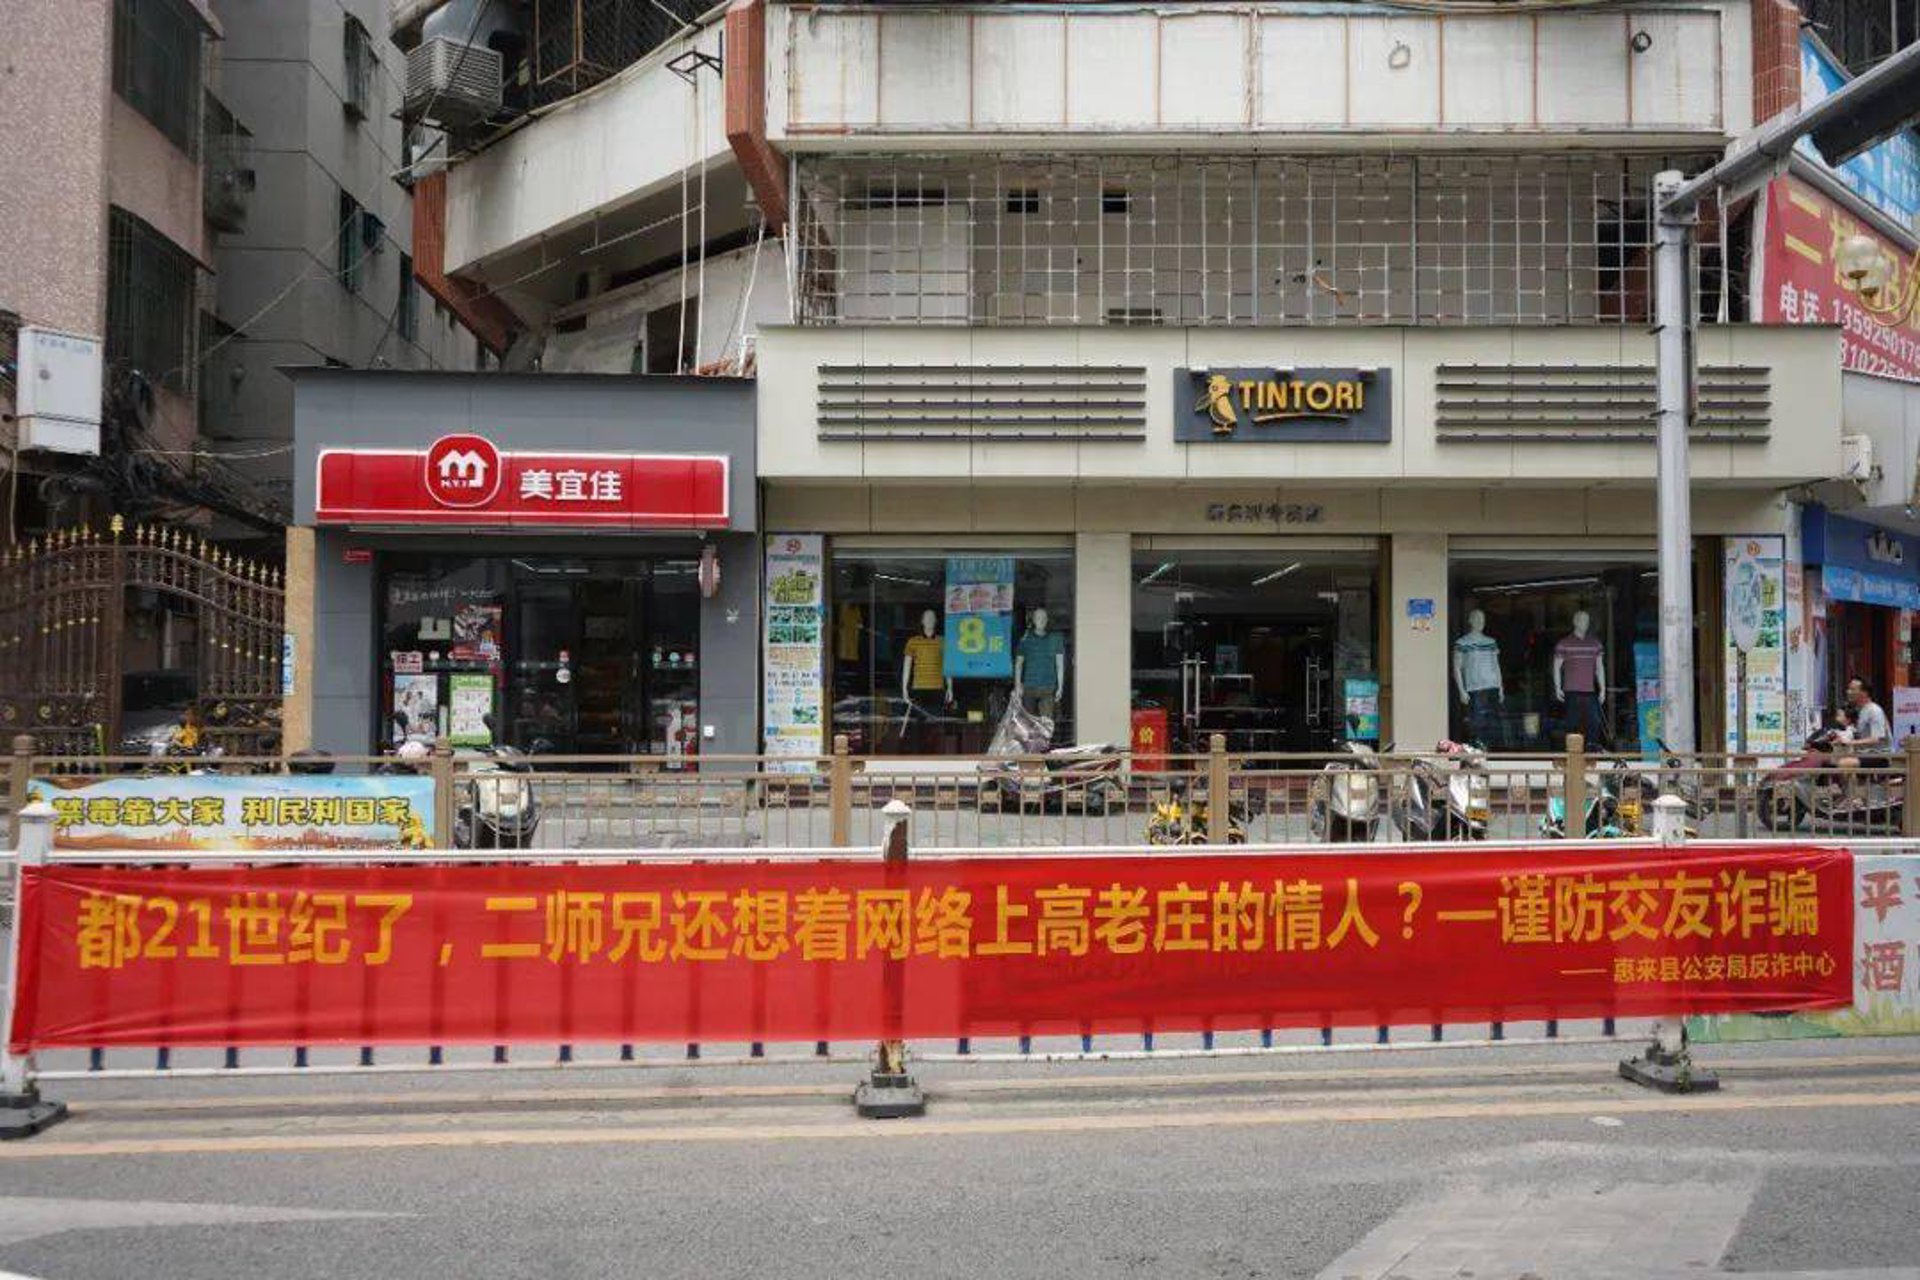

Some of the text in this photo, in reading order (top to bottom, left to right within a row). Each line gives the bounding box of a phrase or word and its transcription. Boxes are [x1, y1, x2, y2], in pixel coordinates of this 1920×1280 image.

[1239, 380, 1363, 410] TINTORI
[520, 469, 621, 501] 美宜佳
[52, 796, 410, 827] 禁毒靠大家 利民利国家
[1860, 871, 1920, 923] 平
